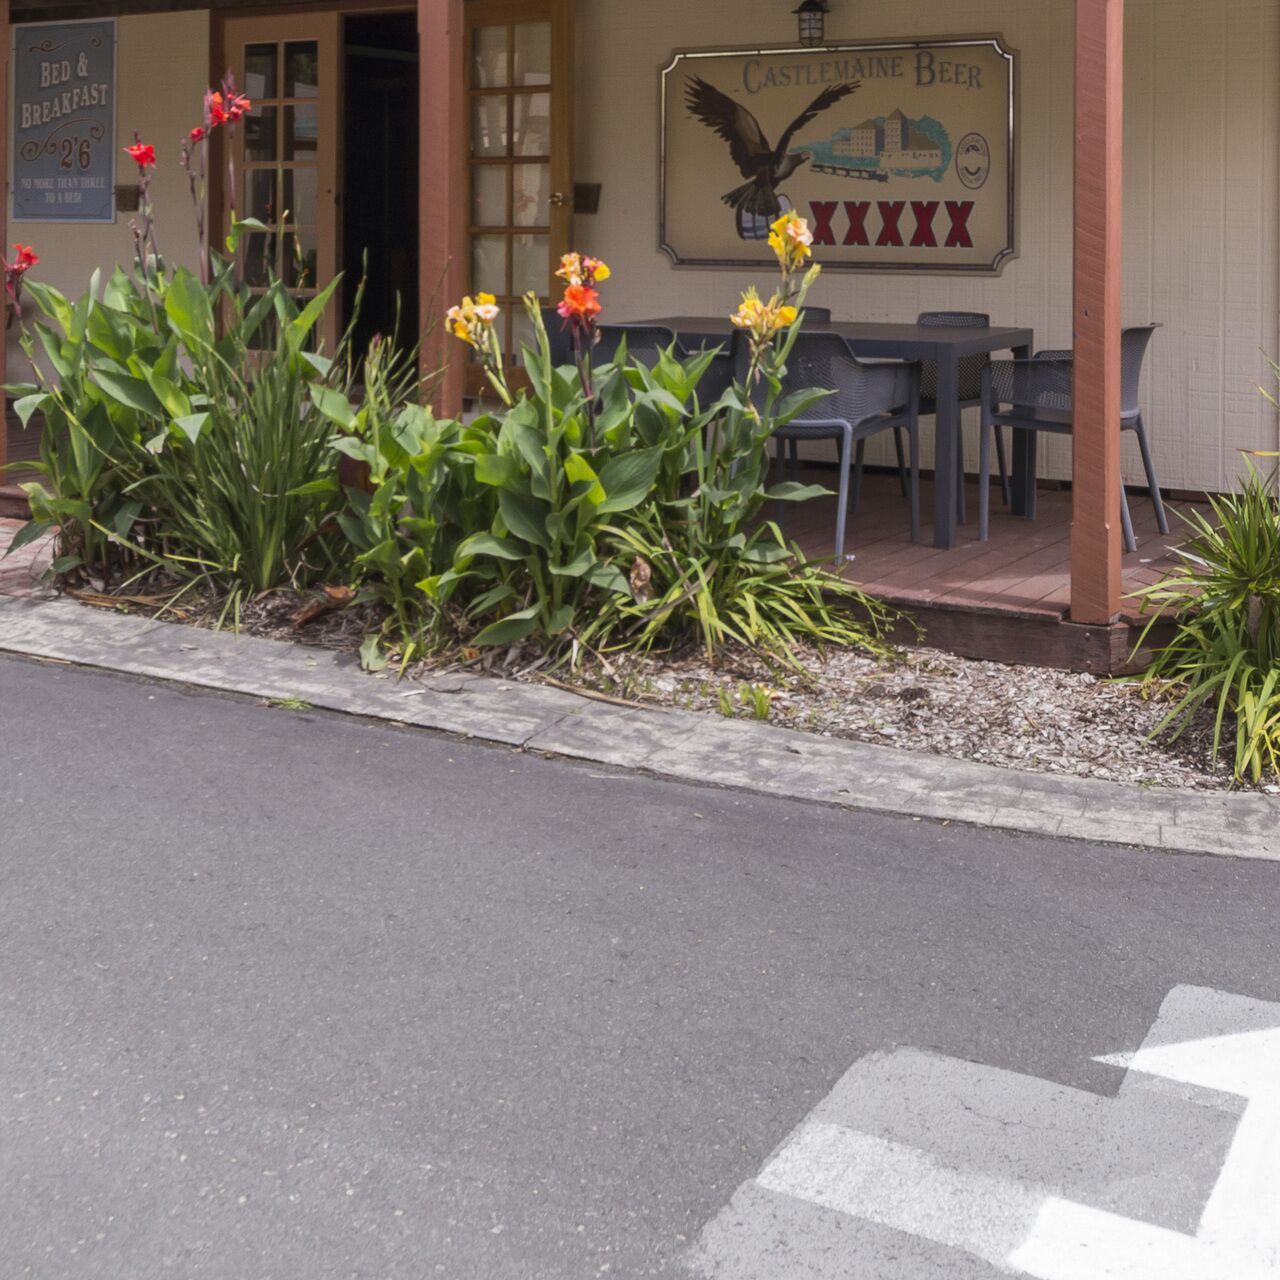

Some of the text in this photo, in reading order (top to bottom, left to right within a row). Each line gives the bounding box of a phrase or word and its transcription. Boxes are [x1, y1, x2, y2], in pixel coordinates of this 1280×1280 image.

[40, 52, 89, 87] BED &
[742, 50, 982, 94] CASTLEMAINE BEER
[21, 84, 109, 129] BREAKFAST
[808, 200, 975, 248] XXXXX
